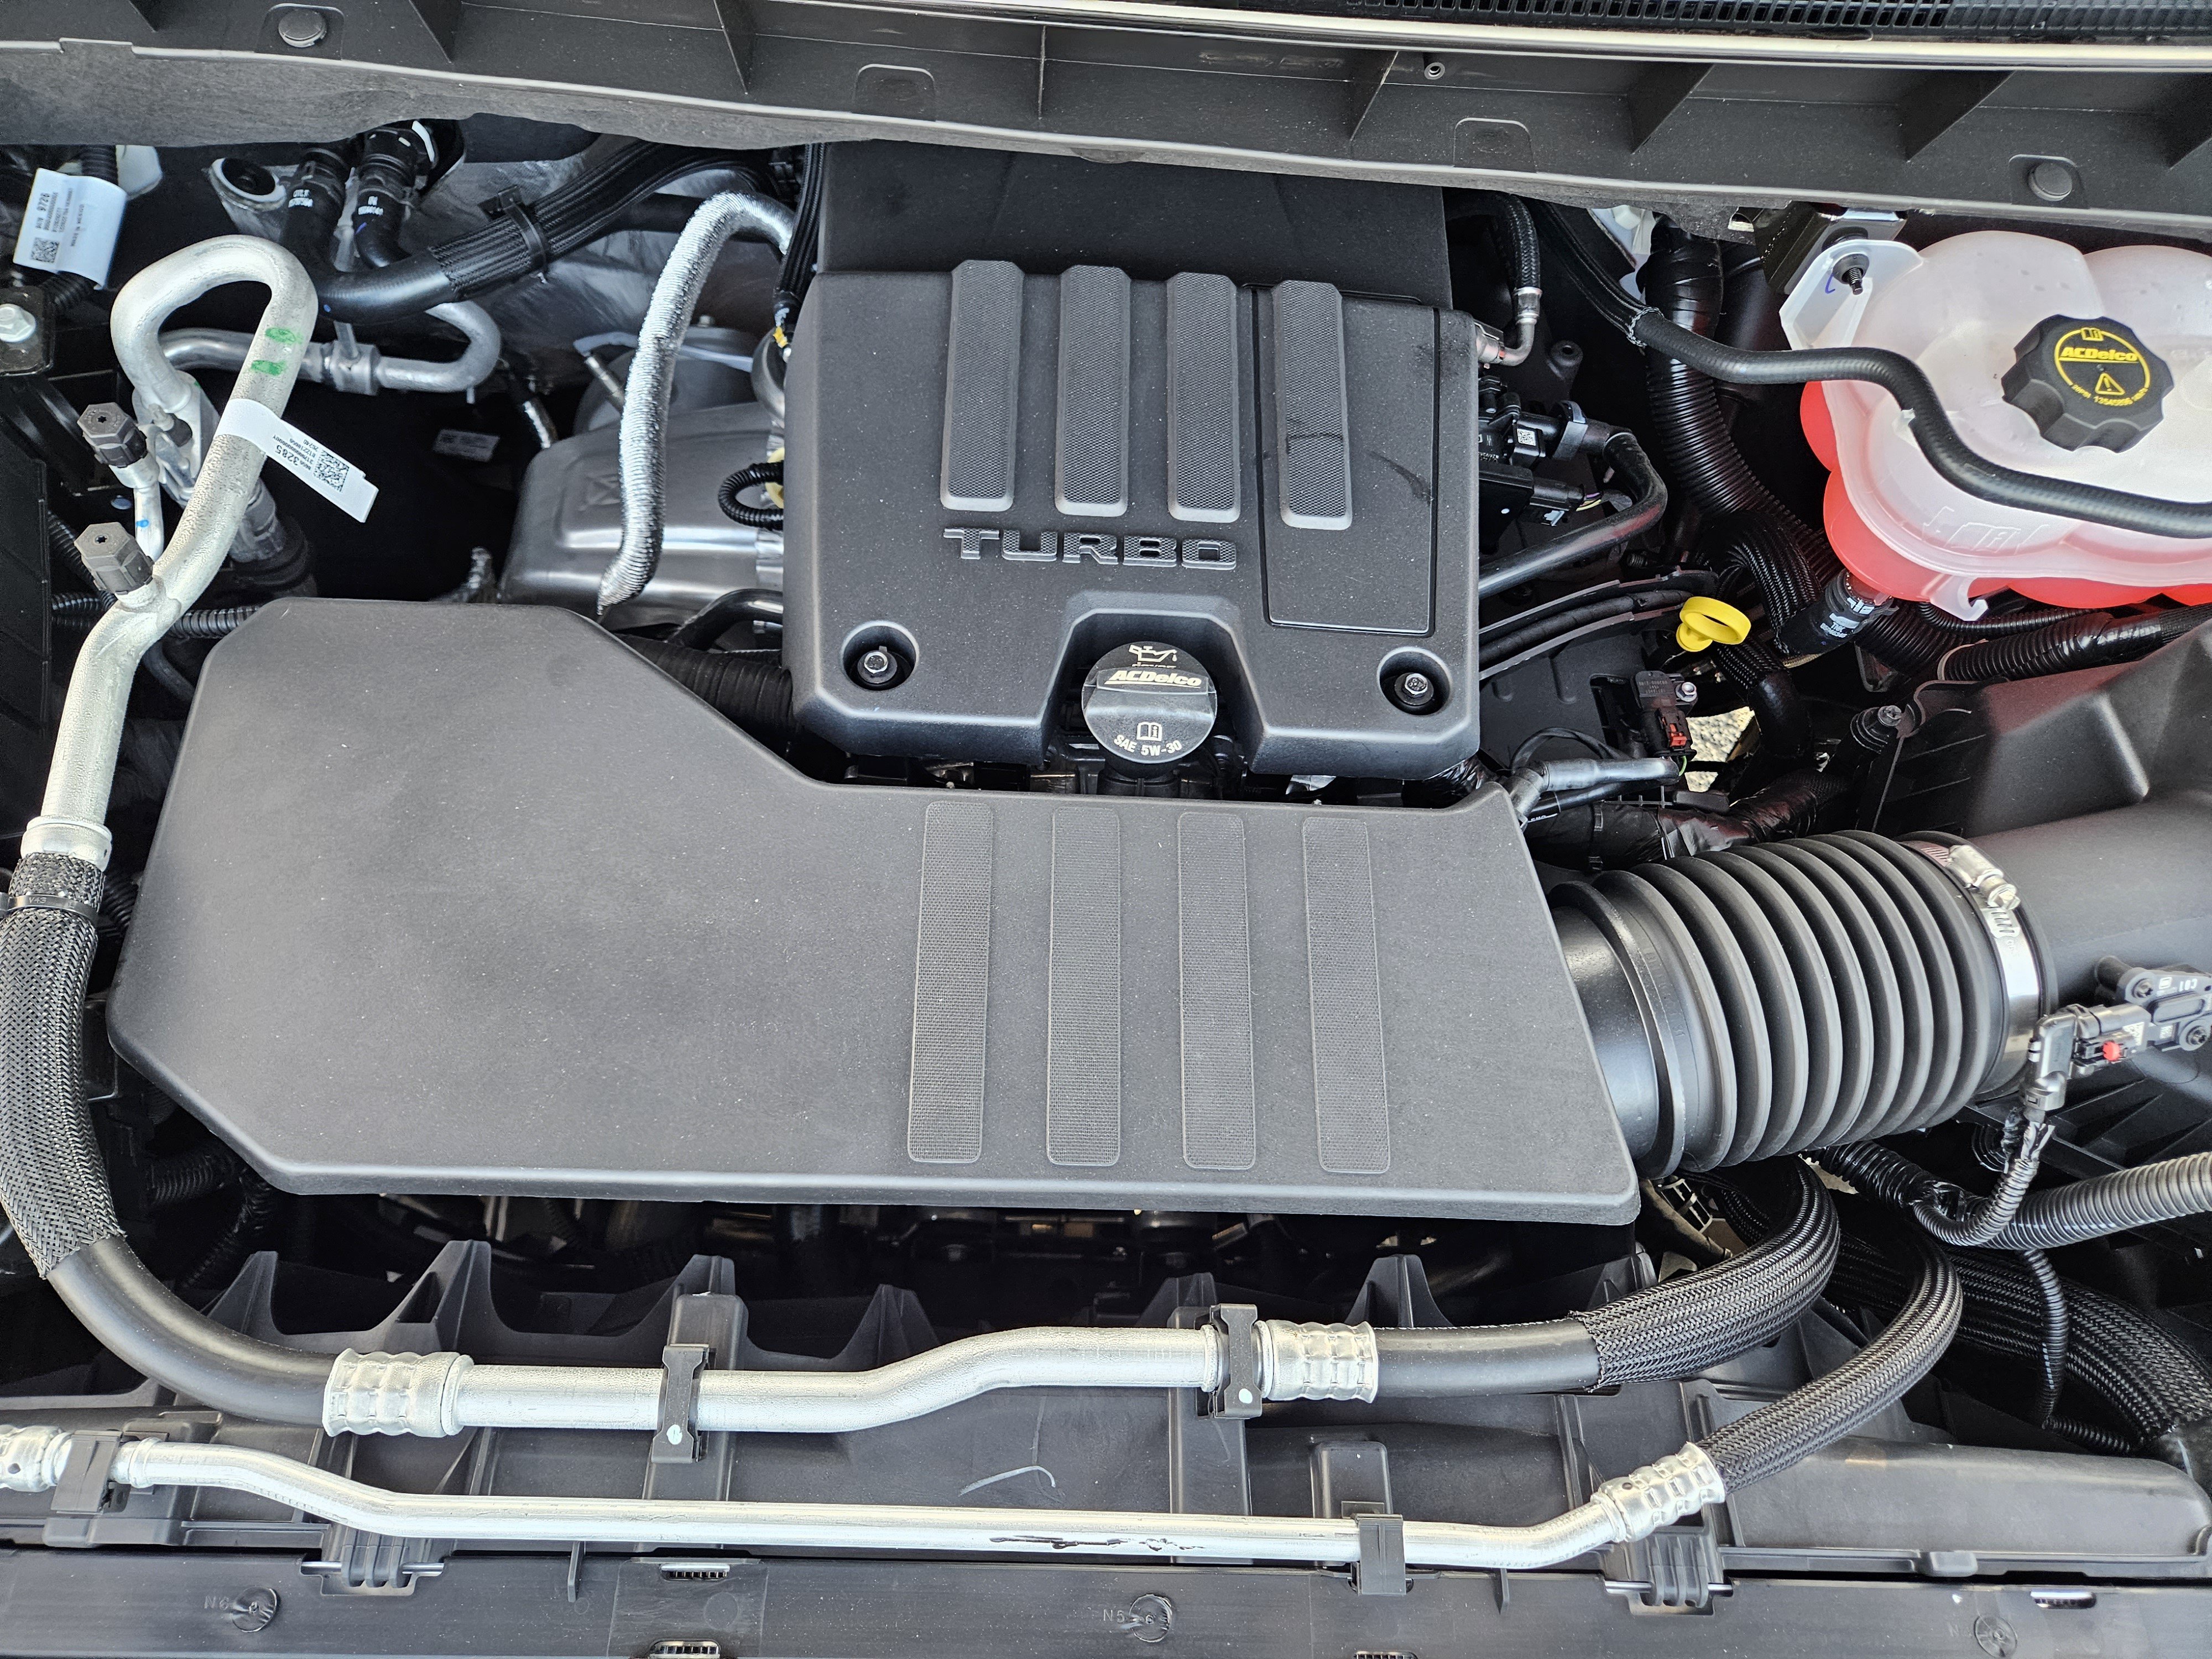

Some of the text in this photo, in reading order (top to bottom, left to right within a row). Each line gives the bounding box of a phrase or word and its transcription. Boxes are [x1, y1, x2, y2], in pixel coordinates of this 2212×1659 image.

[2060, 347, 2138, 361] ACDelco
[275, 445, 300, 466] 3285
[943, 526, 1237, 570] TURBO
[1108, 670, 1202, 687] ACDelco
[1114, 734, 1182, 756] SAE 5W-30
